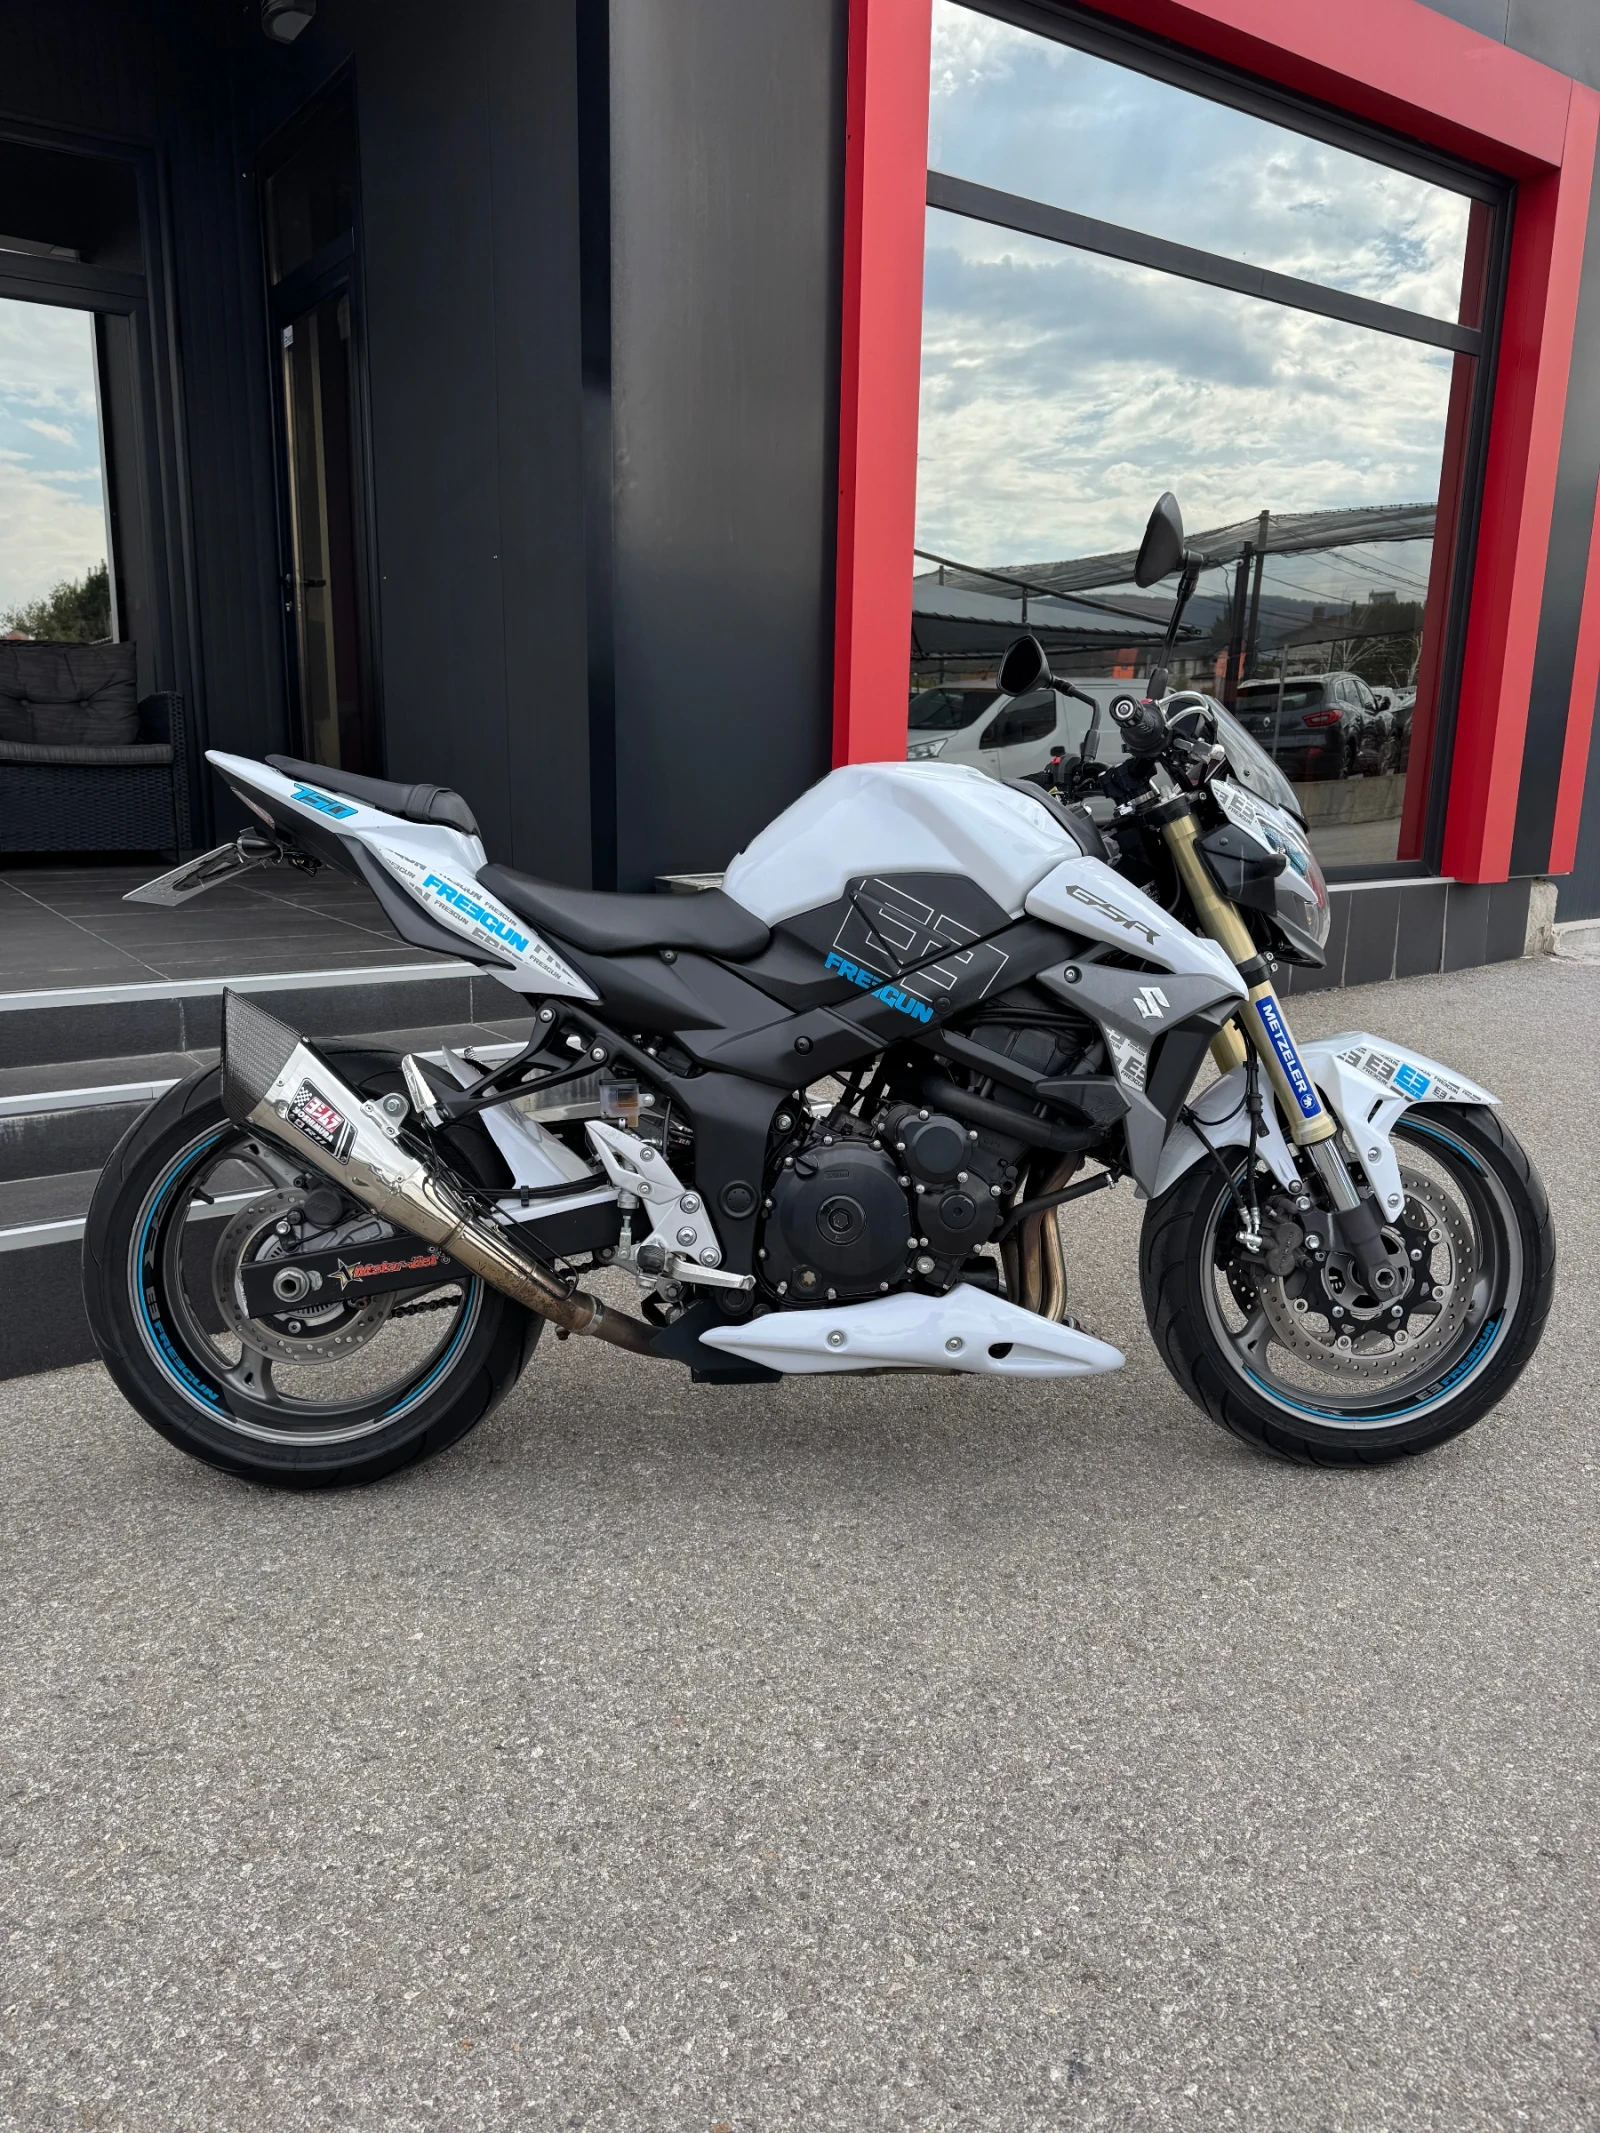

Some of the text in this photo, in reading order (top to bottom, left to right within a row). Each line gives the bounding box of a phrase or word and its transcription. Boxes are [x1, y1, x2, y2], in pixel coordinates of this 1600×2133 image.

[290, 783, 358, 819] 750
[1065, 884, 1161, 946] GSR
[1262, 1004, 1308, 1093] METZELER
[292, 1106, 334, 1142] YOSHIMURA
[303, 1096, 345, 1133] ヨシムラ
